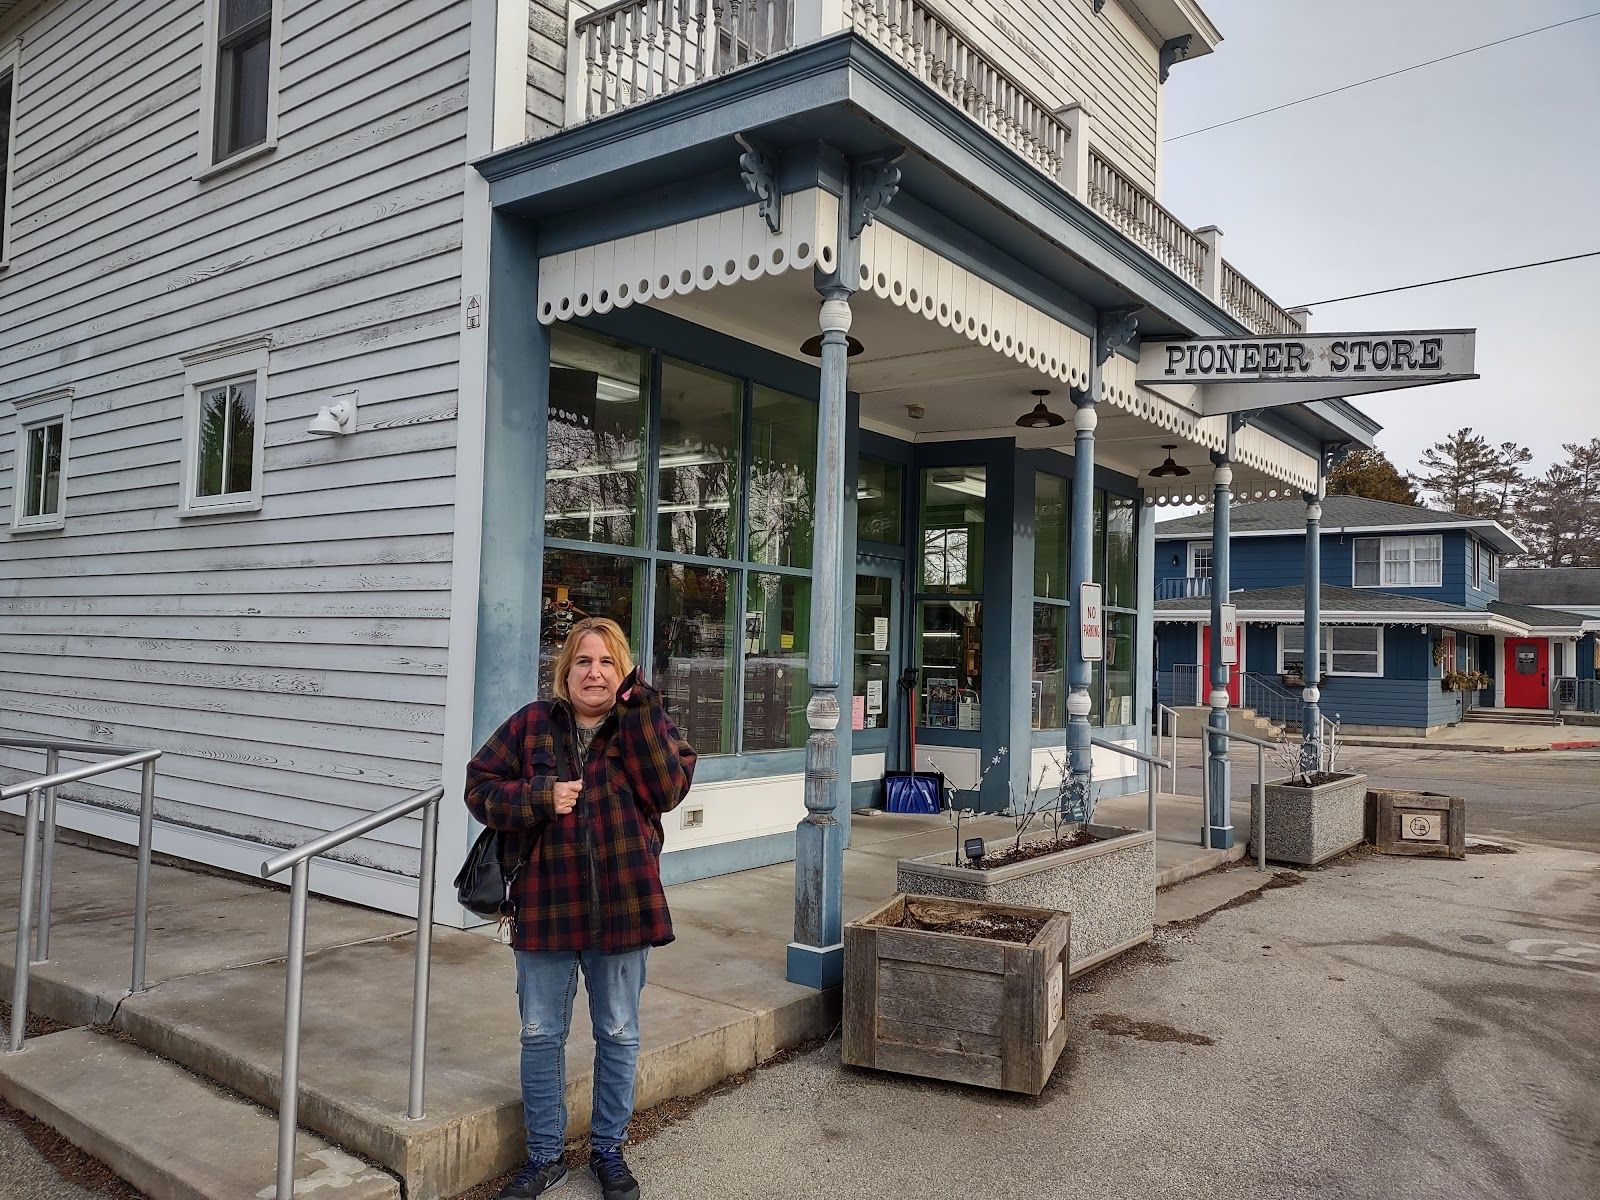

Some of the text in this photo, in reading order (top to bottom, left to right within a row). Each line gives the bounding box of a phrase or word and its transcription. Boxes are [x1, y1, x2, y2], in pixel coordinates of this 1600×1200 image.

[1164, 338, 1443, 375] PIONEER STORE
[1087, 606, 1096, 619] NO
[1083, 624, 1100, 638] PARKING
[1225, 622, 1233, 633] NO
[1222, 636, 1236, 647] PARKING
